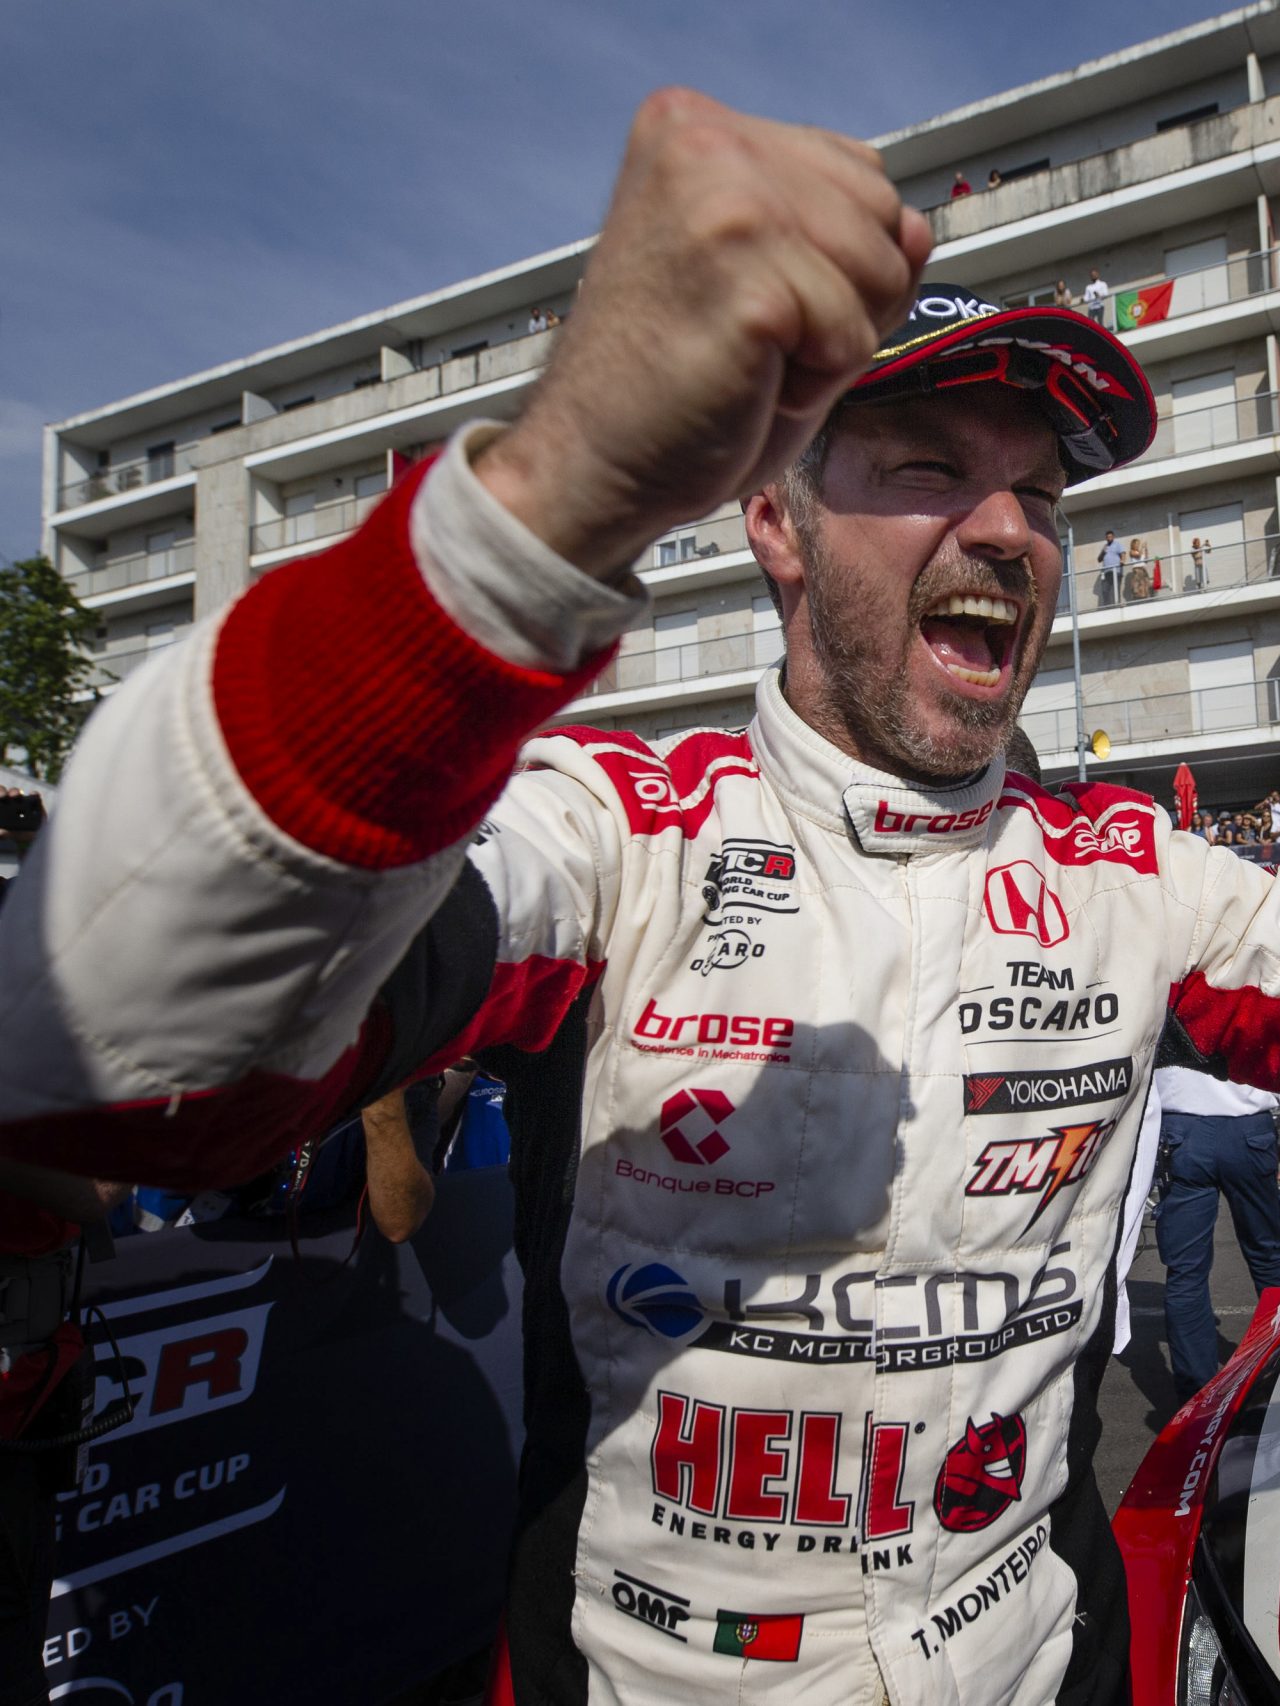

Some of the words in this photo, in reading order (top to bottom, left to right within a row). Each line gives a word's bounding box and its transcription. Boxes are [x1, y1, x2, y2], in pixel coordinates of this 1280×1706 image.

[874, 800, 995, 836] brose
[742, 887, 765, 898] CAR
[766, 891, 790, 902] CUP
[747, 916, 762, 926] BY
[1005, 961, 1074, 991] TEAM
[633, 998, 795, 1048] brose
[961, 993, 1119, 1034] OSCARO
[631, 1039, 694, 1058] Excellence
[698, 1048, 709, 1058] in
[711, 1049, 791, 1064] Mechatronics
[1005, 1067, 1129, 1102] YOKOHAMA
[730, 1331, 773, 1353] KC
[1026, 1311, 1079, 1341] LTD.
[650, 1390, 914, 1545] HELL
[78, 1483, 162, 1532] CAR
[173, 1453, 251, 1501] CUP
[651, 1503, 778, 1552] ENERGY
[108, 1596, 160, 1640] BY
[611, 1581, 691, 1632] OMP
